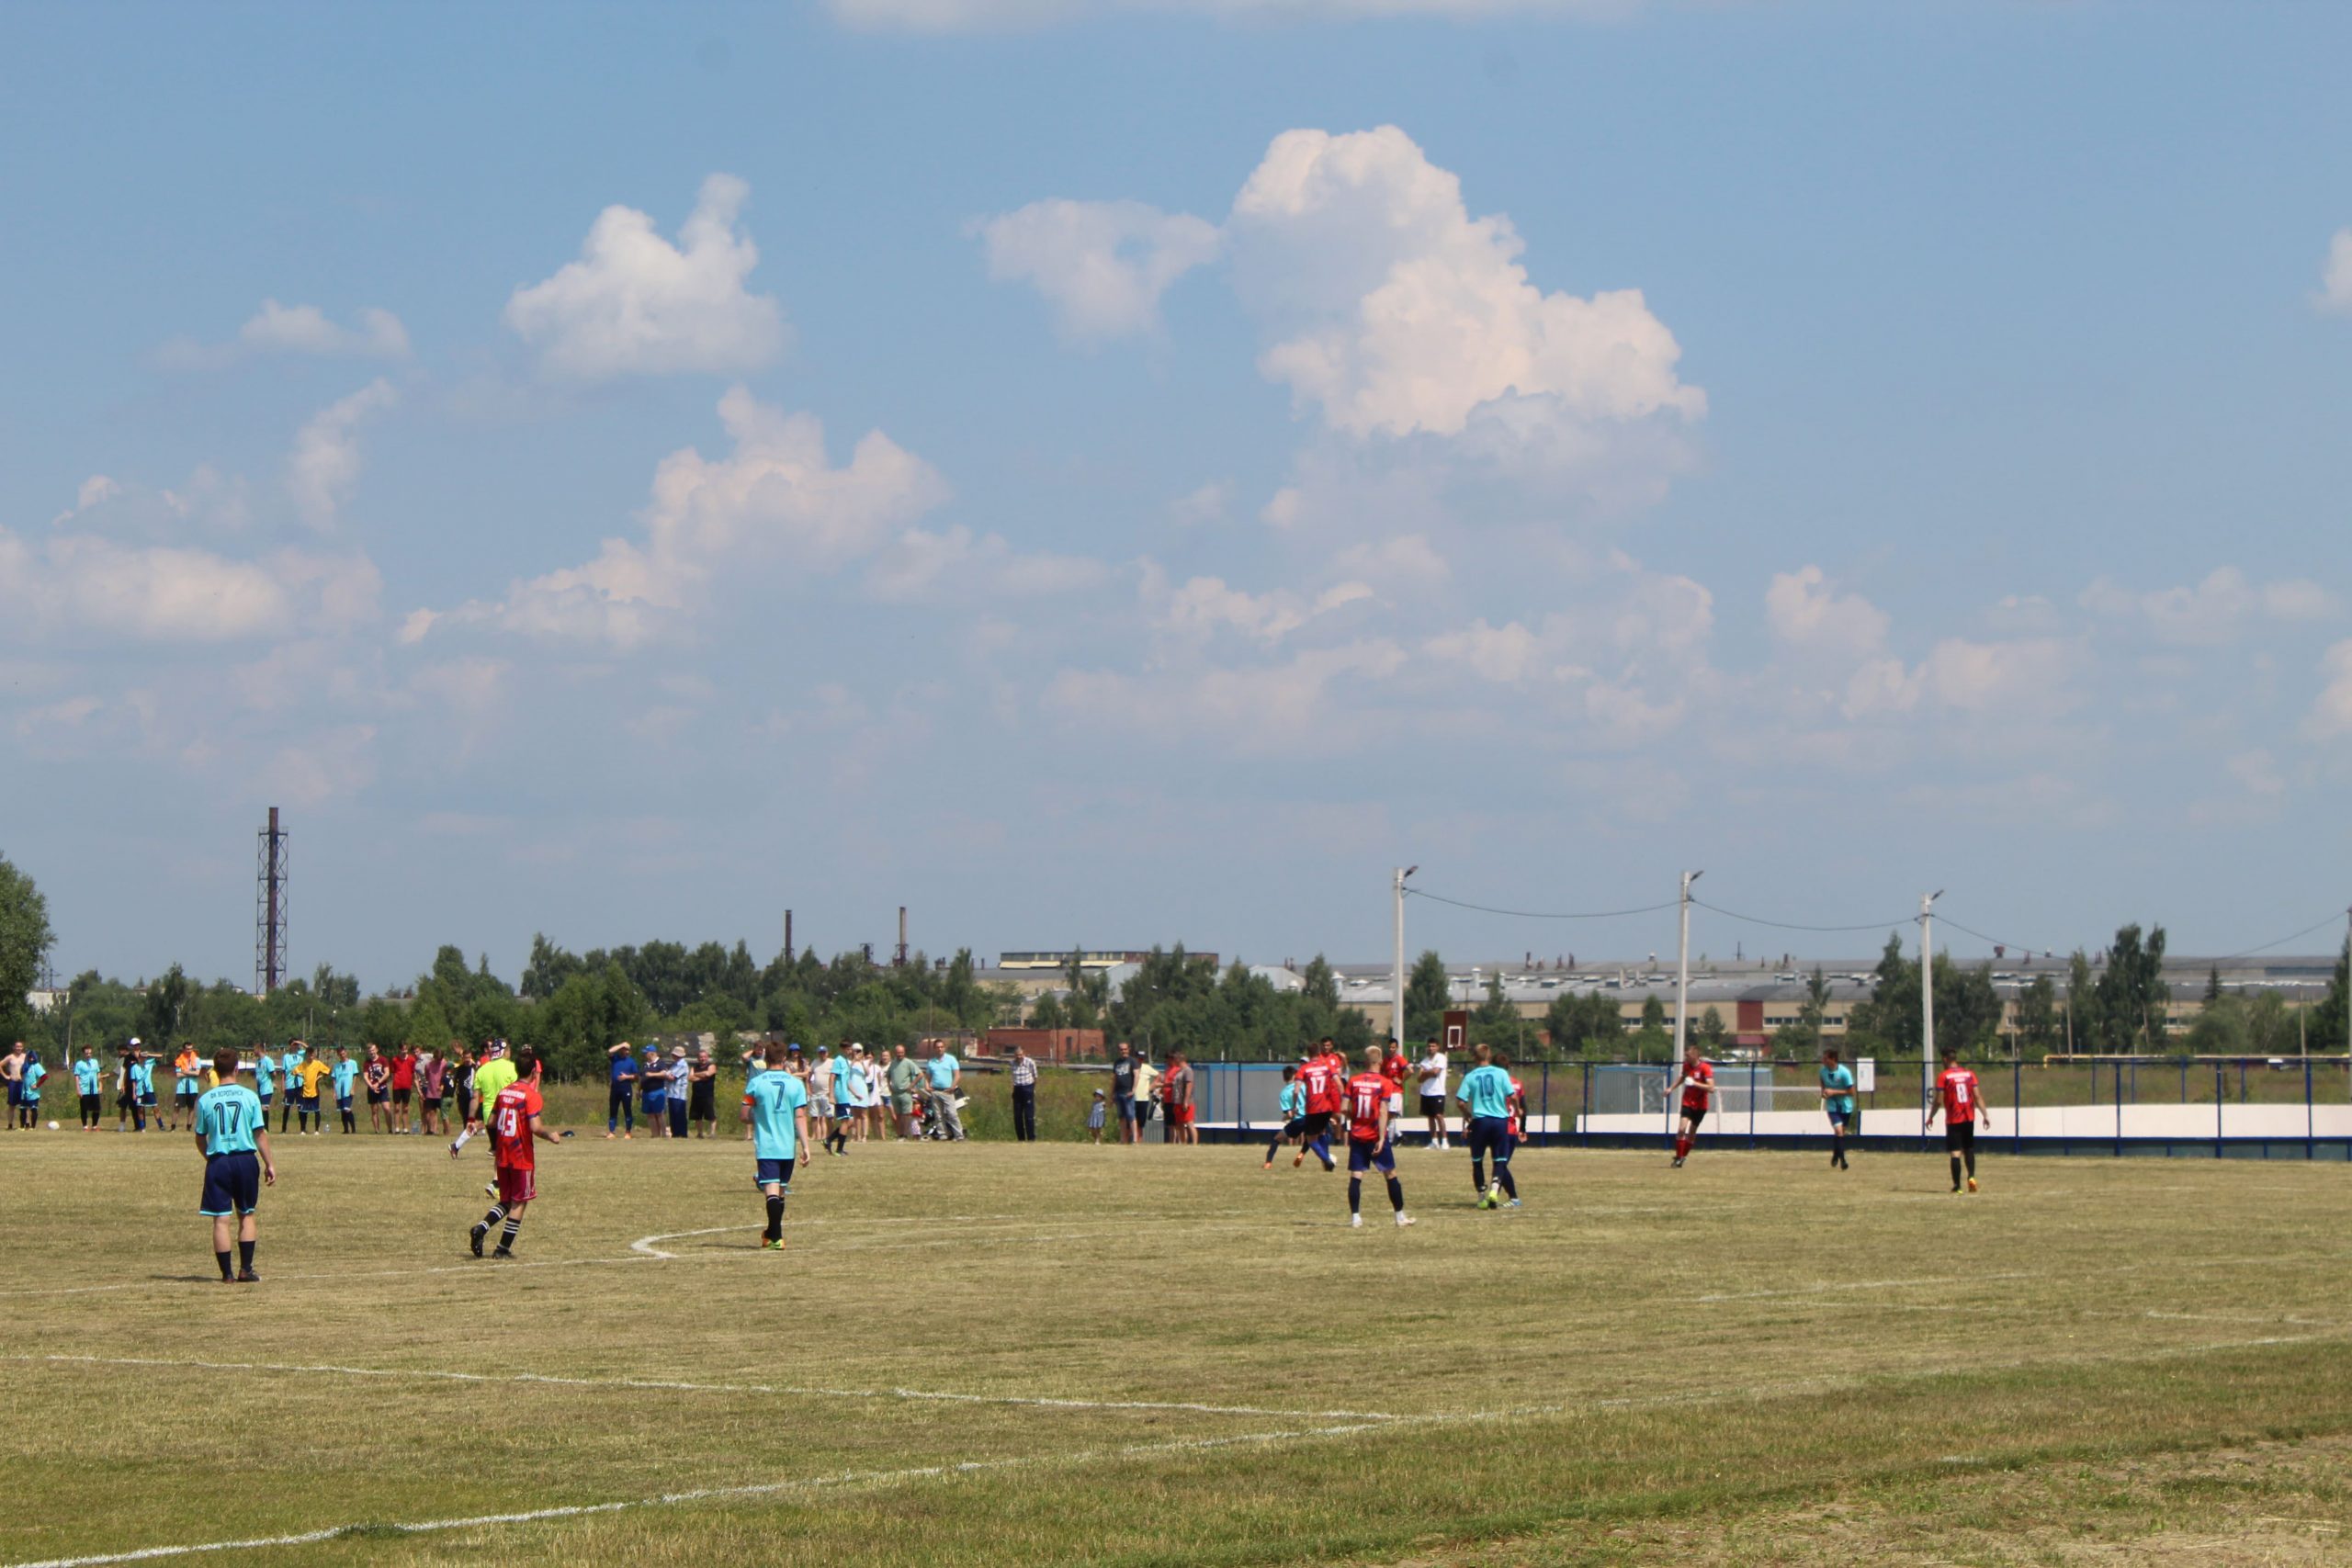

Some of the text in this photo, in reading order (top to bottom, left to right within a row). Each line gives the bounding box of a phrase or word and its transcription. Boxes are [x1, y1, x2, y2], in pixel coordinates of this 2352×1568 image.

[770, 1081, 786, 1110] 7
[1310, 1076, 1326, 1094] 17
[1475, 1074, 1495, 1098] 10
[214, 1100, 242, 1135] 17
[1356, 1094, 1372, 1118] 11
[497, 1107, 517, 1137] 43
